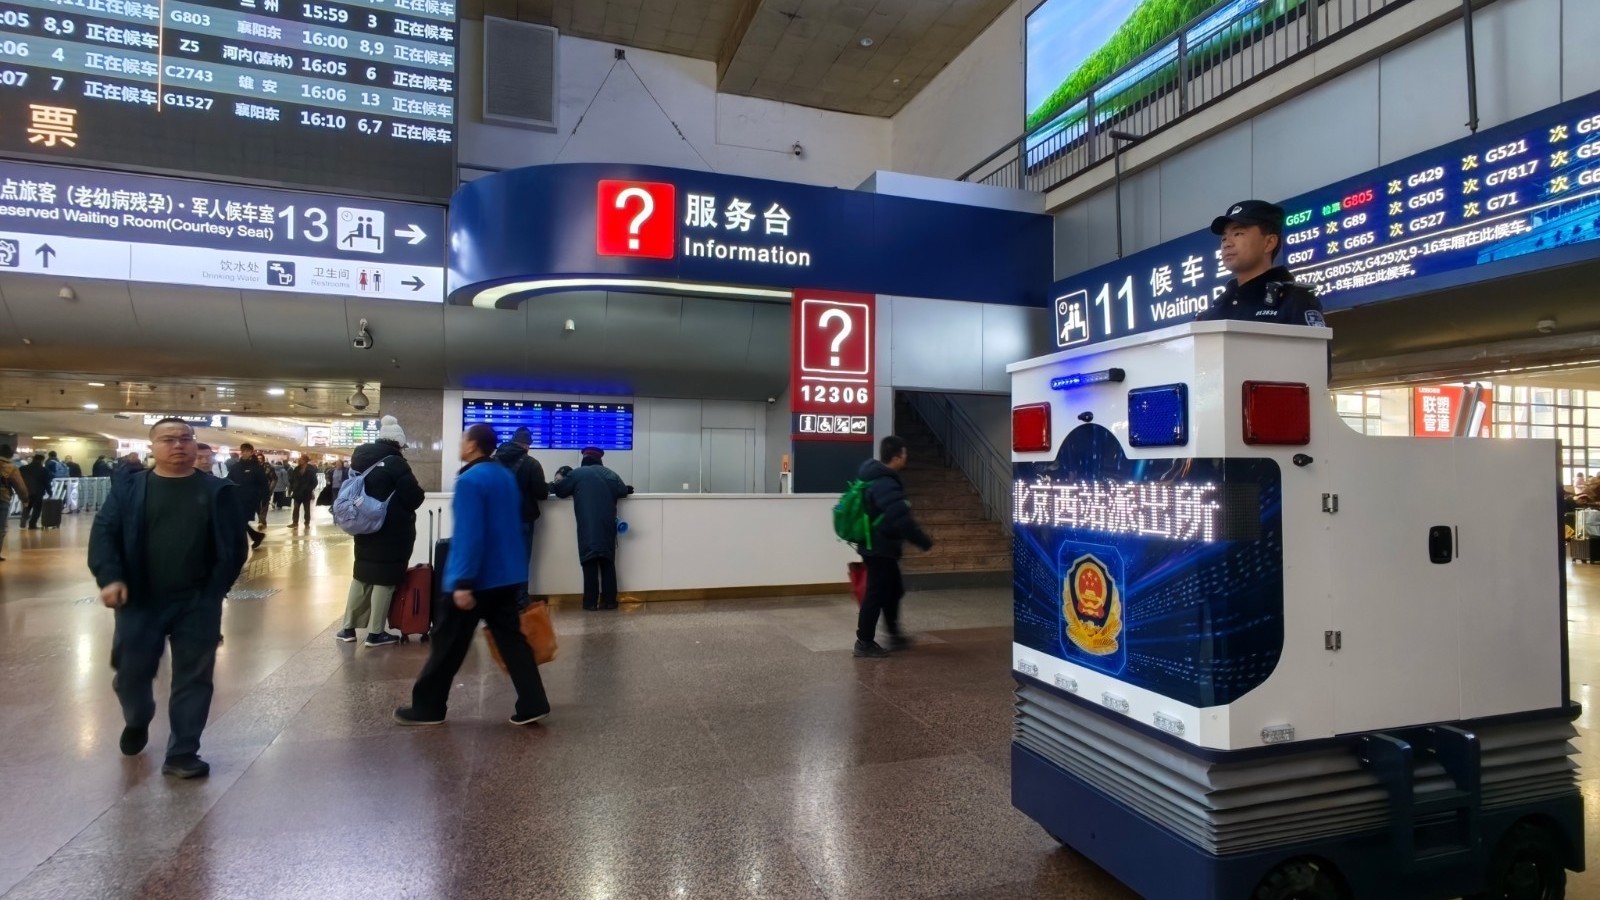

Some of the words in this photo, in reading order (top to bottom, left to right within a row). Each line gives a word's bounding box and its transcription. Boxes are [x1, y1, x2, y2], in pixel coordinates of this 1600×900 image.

[43, 17, 74, 36] 8,9
[86, 23, 159, 49] 正在候车
[171, 10, 210, 26] G803
[237, 20, 281, 40] 襄阳东
[302, 31, 348, 49] 16:00
[359, 39, 385, 56] 8,9
[394, 44, 453, 67] 正在候车
[303, 4, 348, 23] 15:59
[367, 14, 377, 28] 3
[394, 18, 454, 42] 正在候车
[52, 48, 64, 62] 4
[85, 52, 158, 77] 正在候车
[179, 39, 199, 53] Z5
[222, 44, 293, 70] 河内(嘉林)
[302, 57, 347, 76] 16:05
[366, 67, 377, 80] 6
[393, 70, 453, 93] 正在候车
[51, 76, 63, 91] 7
[84, 80, 157, 105] 正在候车
[165, 65, 213, 83] C2743
[301, 84, 347, 102] 16:06
[361, 92, 380, 106] 13
[392, 96, 452, 118] 正在候车
[27, 104, 78, 147] 票
[164, 93, 214, 111] G1527
[234, 102, 280, 122] 襄阳东
[300, 111, 346, 129] 16:10
[357, 118, 382, 135] 6,7
[391, 122, 452, 144] 正在候车
[1286, 210, 1312, 226] G657
[1322, 202, 1341, 216] 检票
[1343, 190, 1373, 208] G805
[1388, 180, 1402, 194] 次
[1408, 166, 1444, 187] G429
[1462, 155, 1478, 170] 次
[1485, 139, 1528, 162] G521
[1549, 125, 1568, 142] 次
[685, 194, 792, 236] 服务台
[1286, 227, 1319, 244] G1515
[1326, 221, 1338, 234] 次
[1343, 213, 1366, 228] G89
[1389, 201, 1403, 215] 次
[1408, 188, 1444, 208] G505
[1463, 178, 1479, 194] 次
[1486, 160, 1539, 186] G7817
[1550, 151, 1569, 167] 次
[63, 208, 119, 228] Waiting
[124, 213, 233, 238] Room(Courtesy
[237, 221, 274, 242] Seat)
[278, 204, 329, 242] 13
[1288, 249, 1314, 264] G507
[1327, 241, 1339, 254] 次
[1344, 232, 1375, 249] G665
[1389, 223, 1403, 237] 次
[1409, 211, 1445, 231] G527
[1463, 202, 1480, 217] 次
[1487, 192, 1518, 210] G71
[1550, 176, 1569, 193] 次
[220, 259, 260, 273] 饮水处
[685, 237, 810, 266] Information
[202, 271, 234, 282] Drinking
[237, 273, 260, 283] Water
[311, 279, 350, 289] Restrooms
[313, 266, 350, 280] 卫生间
[1096, 275, 1134, 334] 11
[1151, 295, 1208, 321] Waiting
[801, 385, 868, 404] 12306
[1423, 396, 1450, 414] 联塑
[1424, 414, 1450, 432] 管道
[1013, 479, 1220, 542] 北京西站派出所
